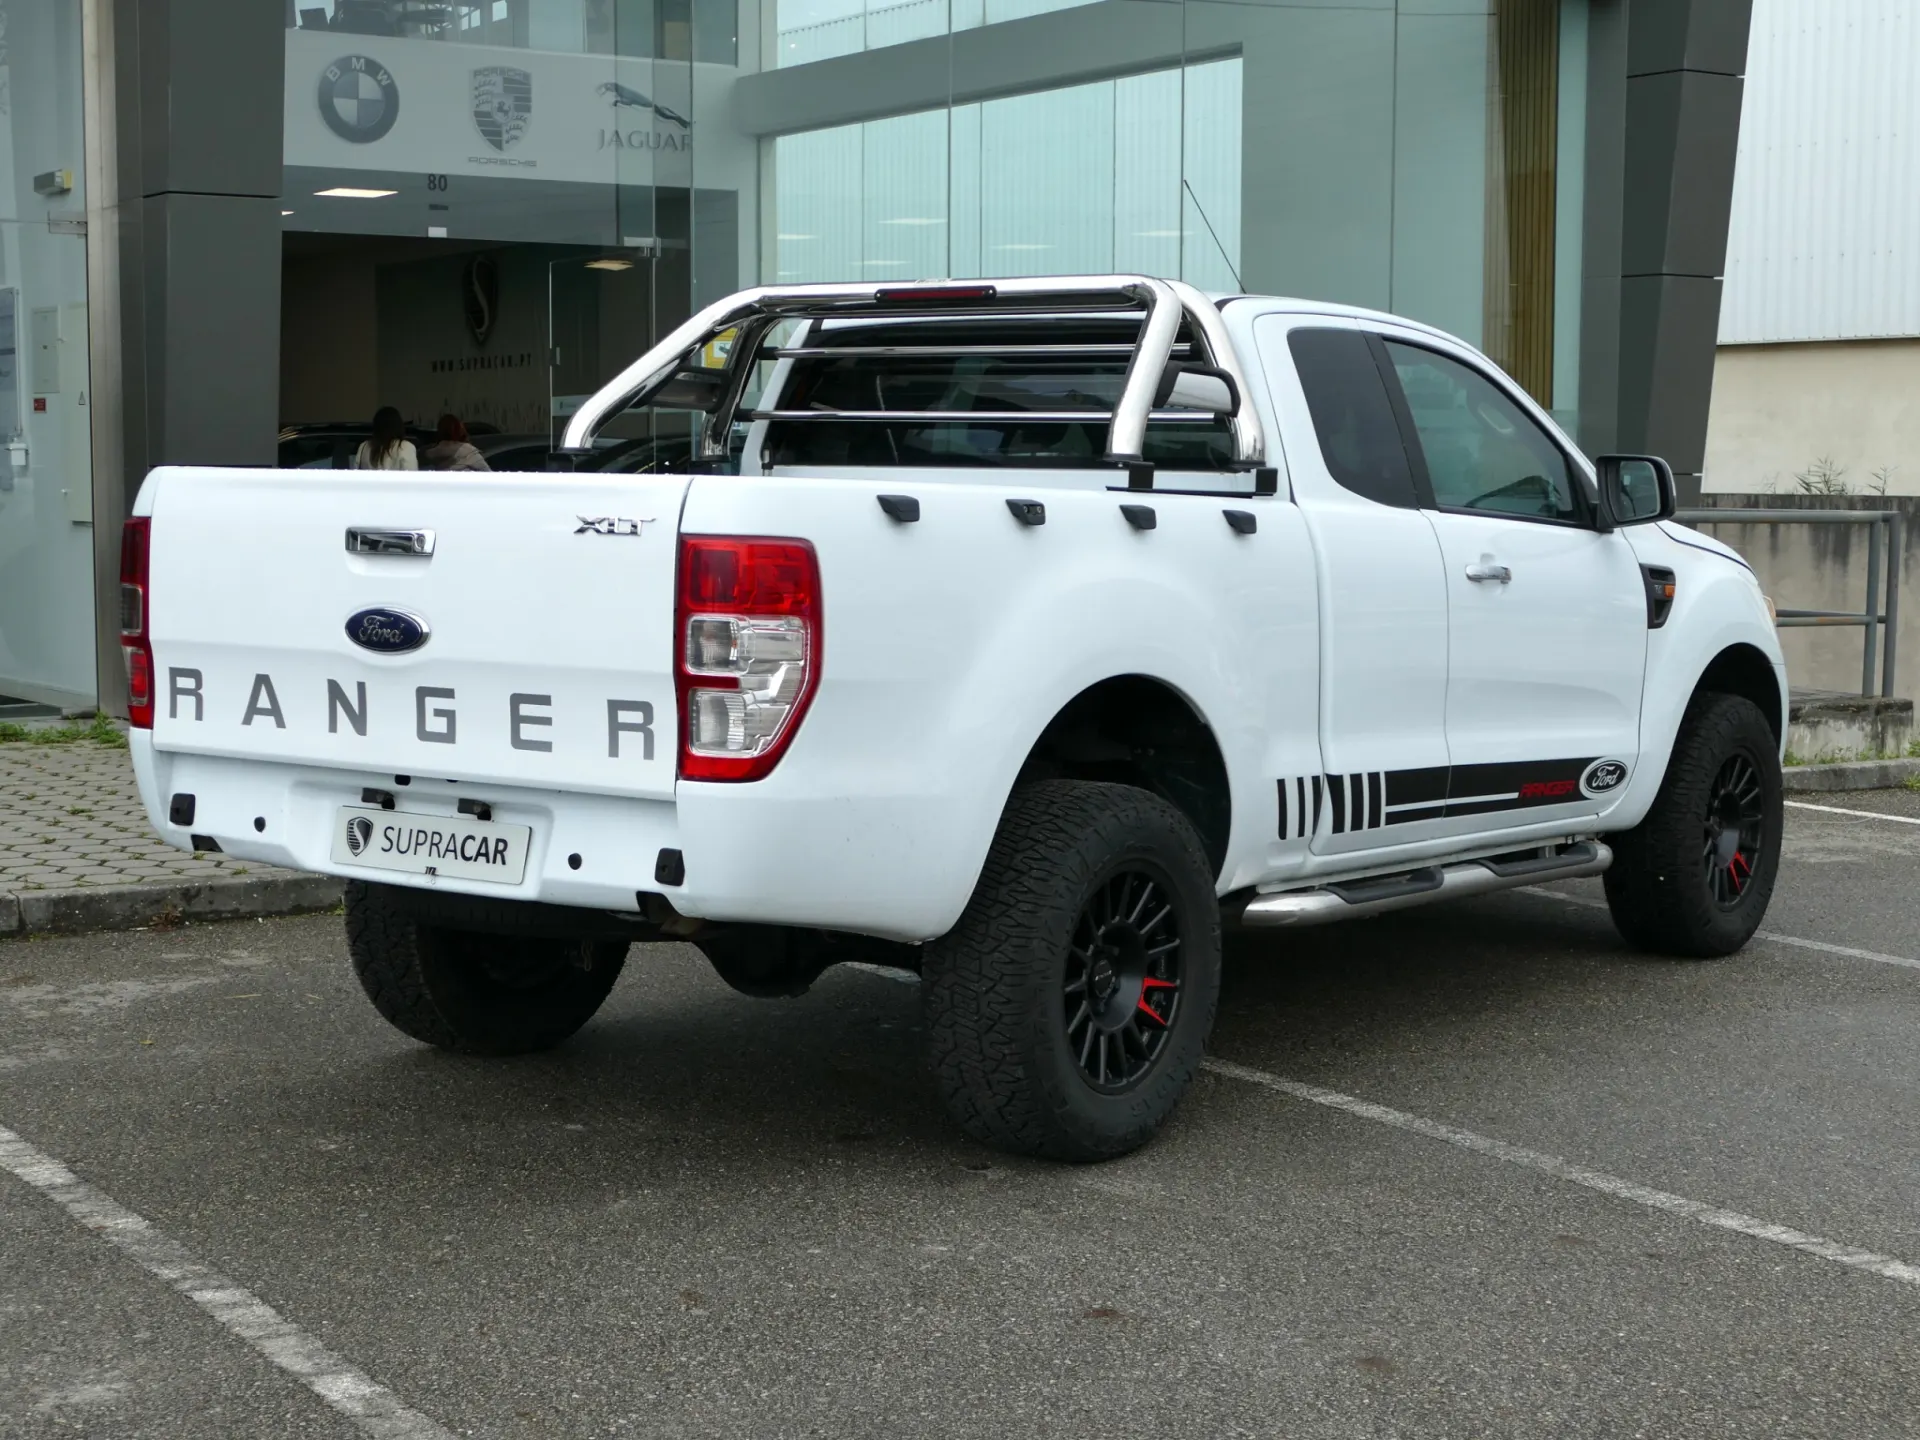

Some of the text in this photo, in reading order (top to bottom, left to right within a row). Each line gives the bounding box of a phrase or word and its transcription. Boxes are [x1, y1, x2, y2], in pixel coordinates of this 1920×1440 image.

[326, 56, 391, 86] BMW
[468, 156, 537, 167] PORSCHE
[428, 173, 448, 192] 80
[573, 515, 656, 536] XLT
[359, 615, 405, 643] Ford
[168, 666, 655, 760] RANGER
[1592, 765, 1620, 787] Ford
[1520, 780, 1576, 798] RANGER
[381, 826, 508, 866] SUPRACAR
